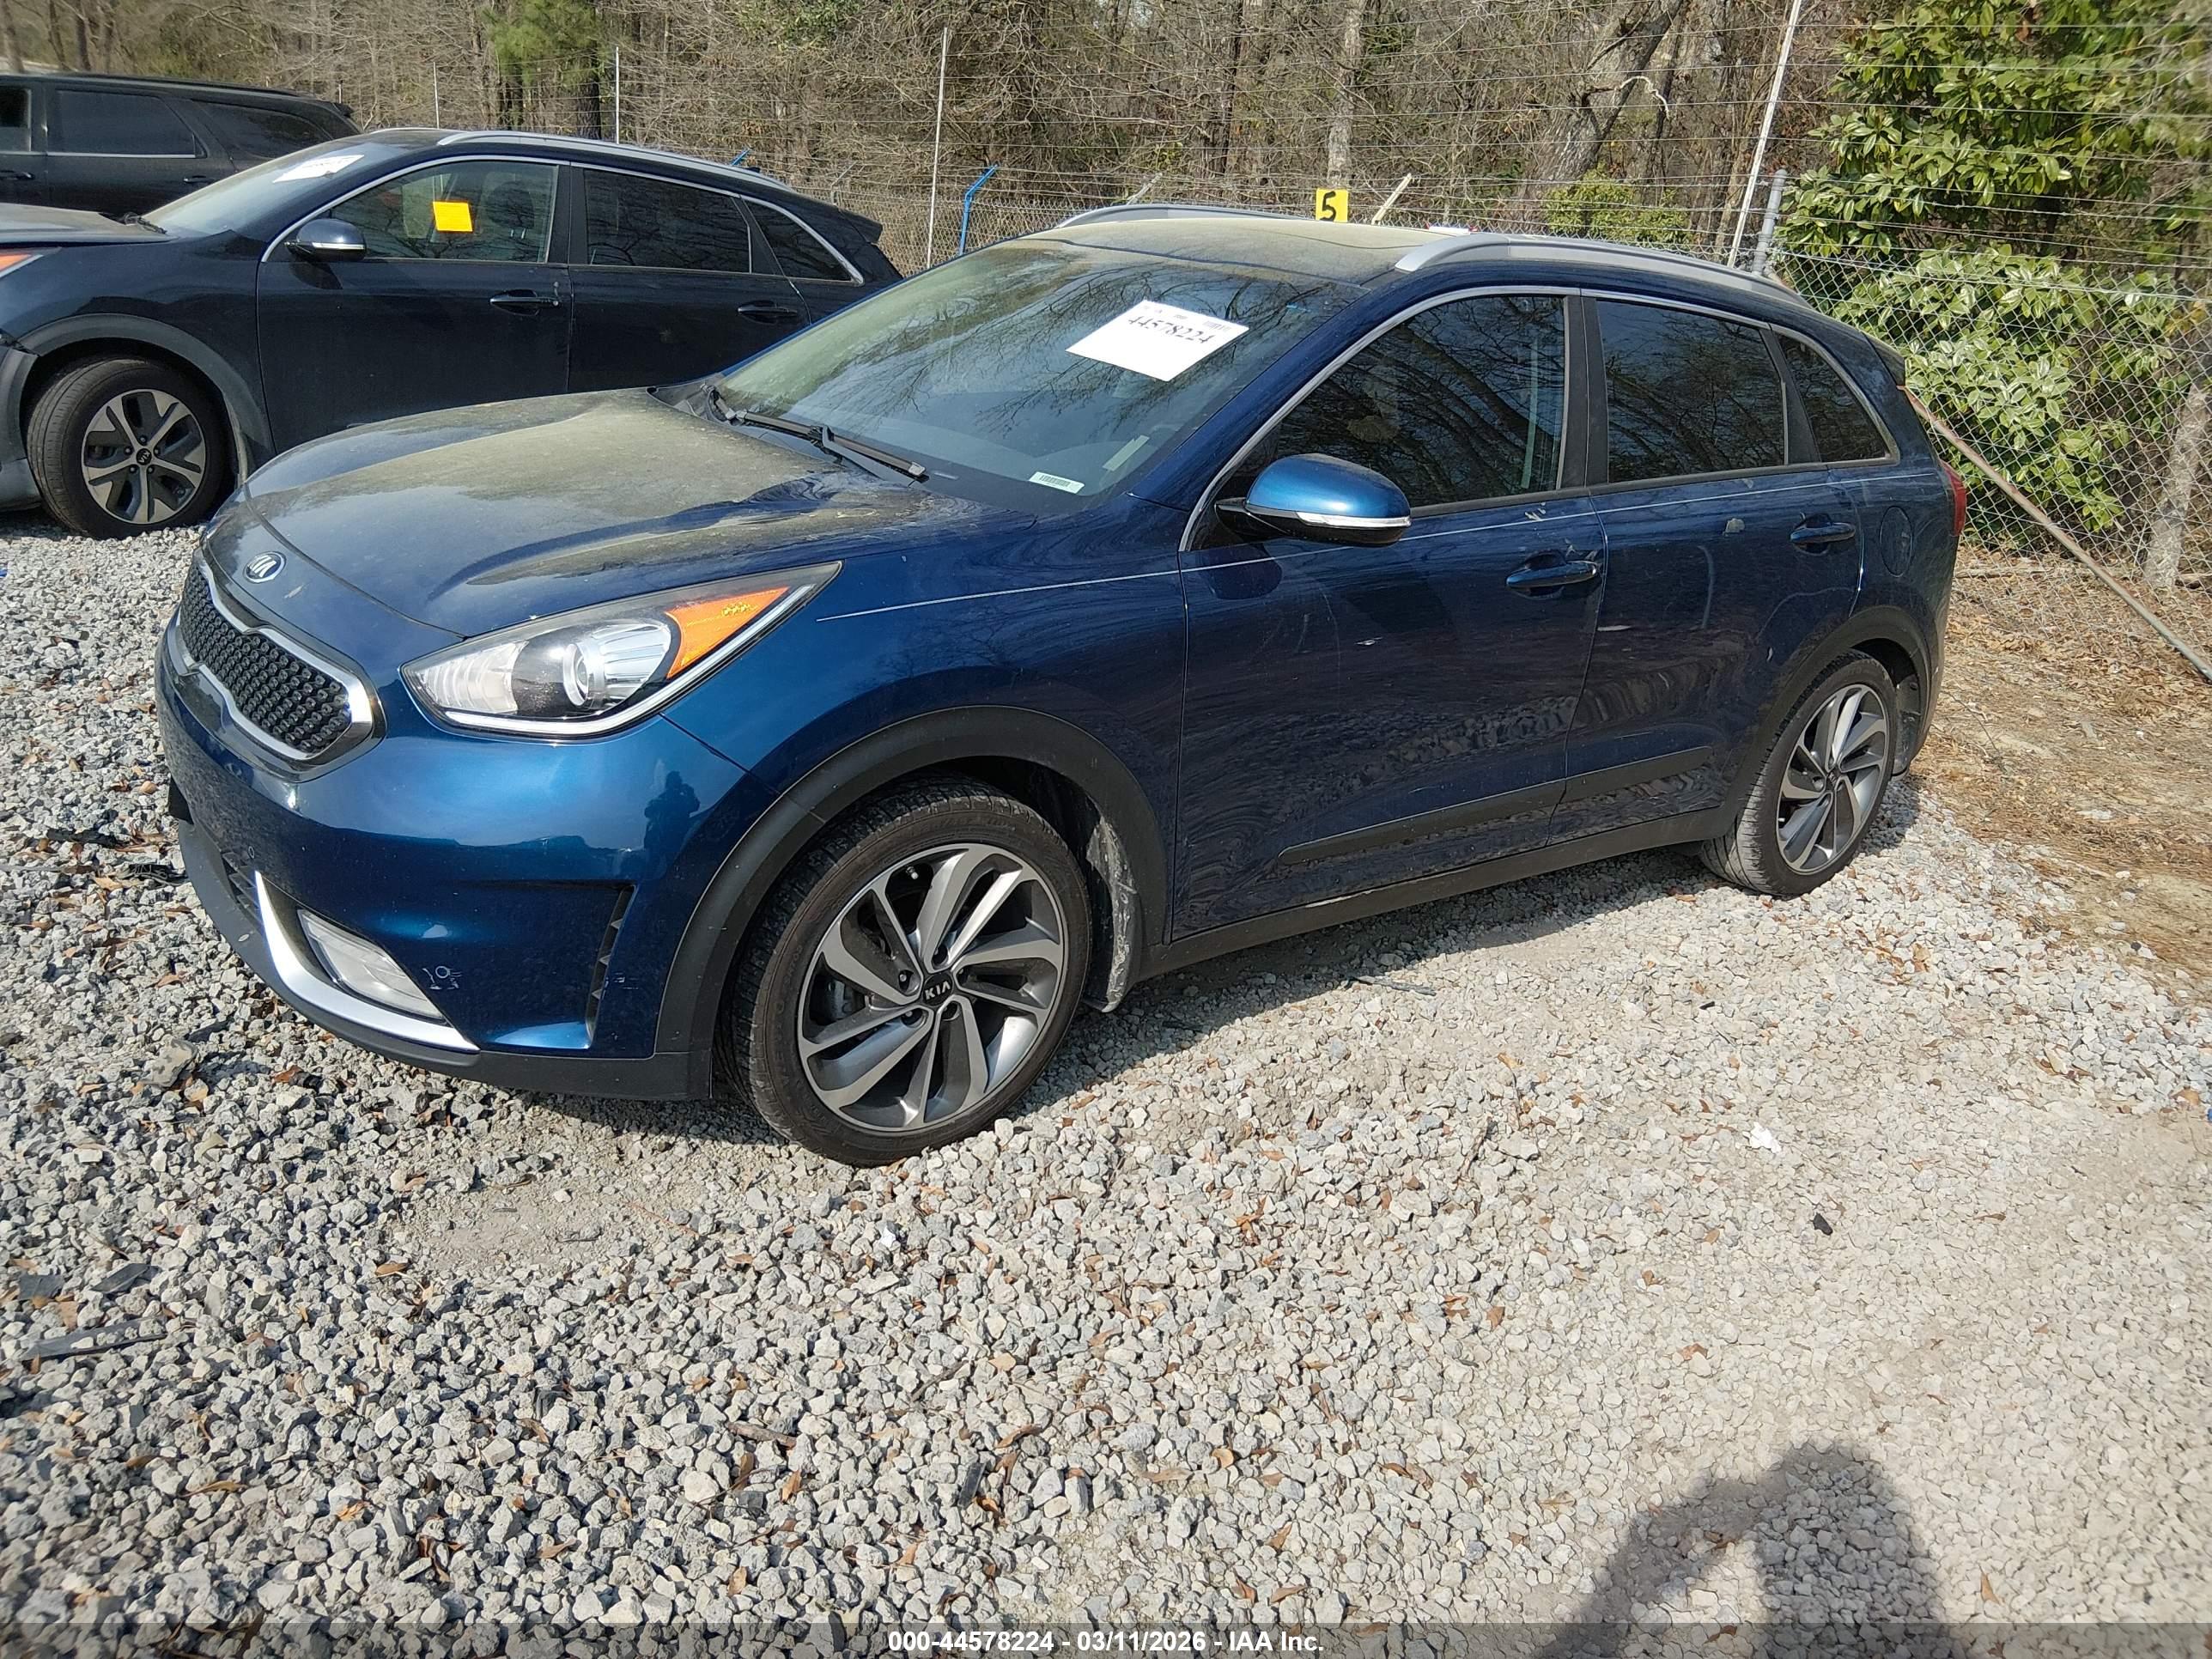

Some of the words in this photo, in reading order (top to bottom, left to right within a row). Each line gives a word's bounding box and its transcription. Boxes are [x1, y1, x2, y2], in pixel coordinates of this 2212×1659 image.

[1320, 191, 1336, 222] 5
[1128, 316, 1216, 343] 44578224
[925, 981, 951, 1000] KIA
